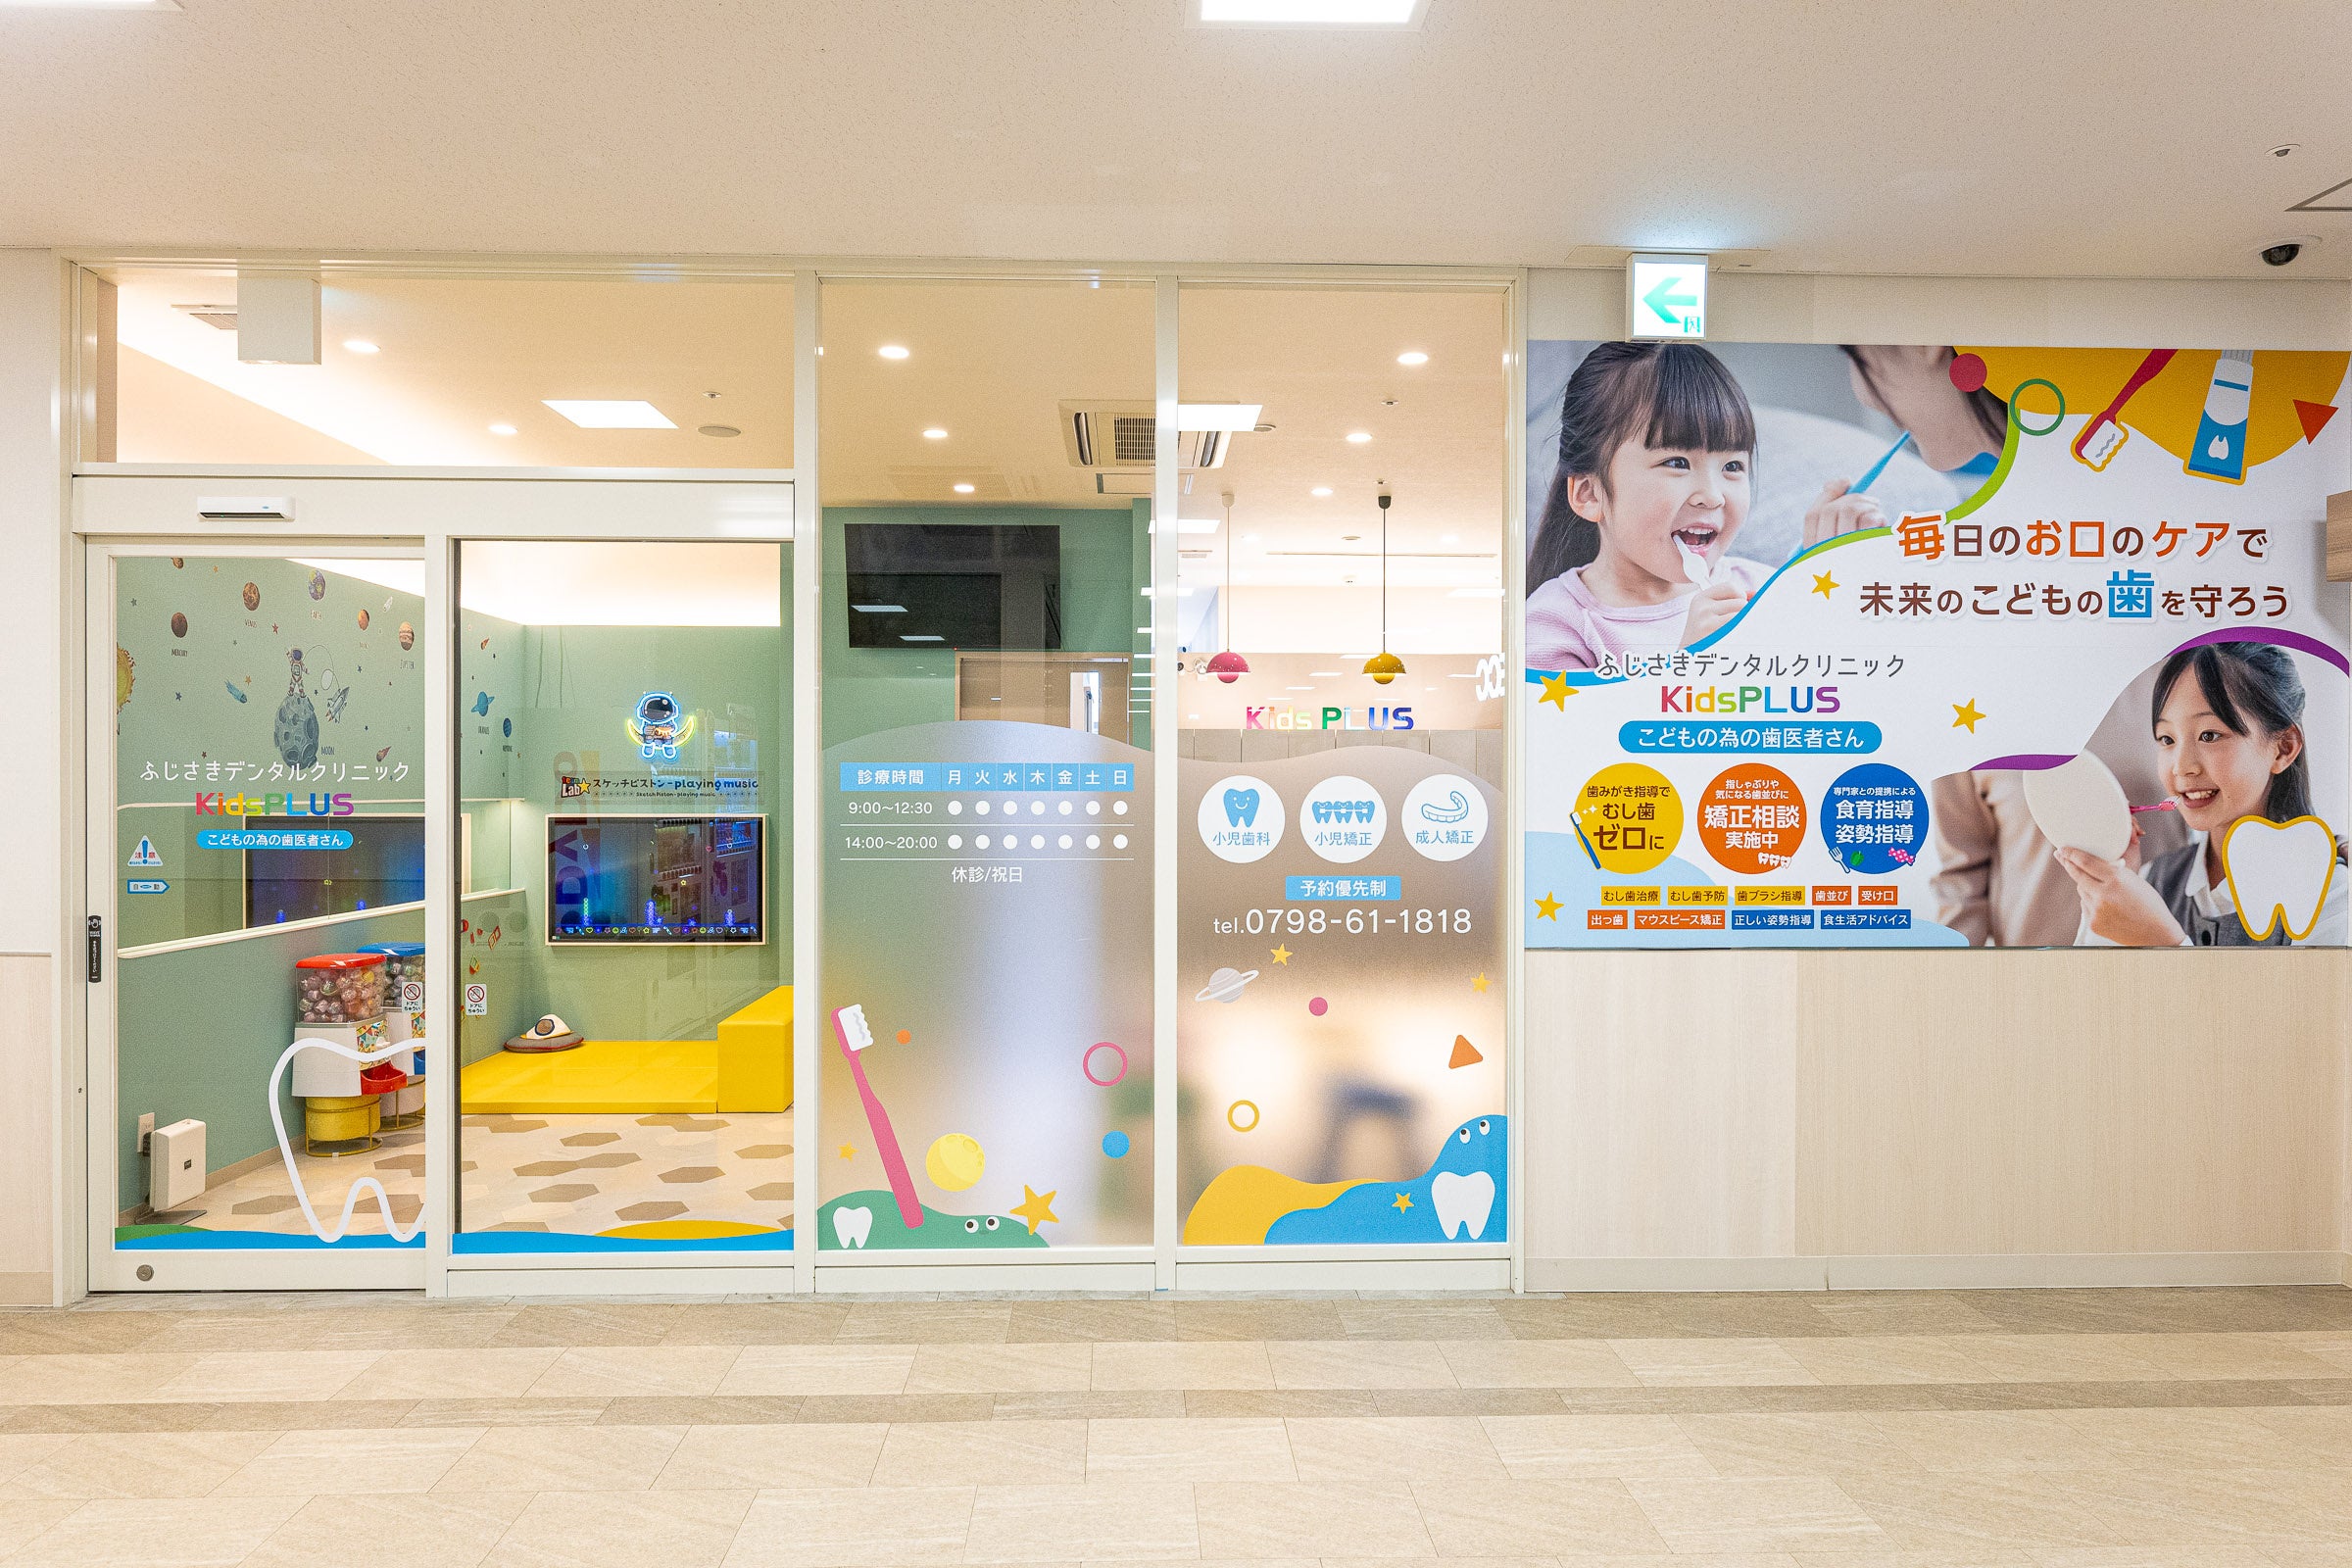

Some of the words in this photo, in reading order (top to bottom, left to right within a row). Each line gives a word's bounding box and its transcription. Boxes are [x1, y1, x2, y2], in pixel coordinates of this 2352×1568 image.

[1896, 514, 2268, 561] 毎日のお口のケアで
[1861, 569, 2287, 618] 未来のこどもの歯を守ろう
[1597, 653, 1905, 677] ふじさきデンタルクリニック
[1661, 686, 1840, 713] KidsPLUS
[1246, 707, 1313, 730] Kids
[1322, 707, 1414, 730] PLUS
[1638, 727, 1864, 748] こどもの為の歯医者さん
[139, 761, 410, 783] ふじさきデンタルクリニック
[858, 769, 924, 785] 診療時間
[948, 770, 961, 785] 月
[975, 769, 990, 785] 火
[1003, 769, 1018, 785] 水
[1030, 769, 1046, 785] 木
[1057, 769, 1073, 785] 金
[1085, 769, 1101, 785] 土
[1113, 769, 1127, 785] 日
[562, 784, 580, 798] Lab
[723, 779, 759, 788] music
[1725, 779, 1780, 790] 指しゃぶりや
[1587, 785, 1671, 799] 歯みがき指導で
[1715, 790, 1788, 800] 気になる歯並びに
[1833, 787, 1916, 797] 専門家との提携による
[195, 792, 355, 816] KidsPLUS
[1602, 803, 1655, 820] むし歯
[1836, 800, 1914, 820] 食育指導
[1704, 805, 1800, 829] 矯正相談
[207, 833, 344, 847] こどもの為の歯医者さん
[1212, 831, 1271, 847] 小児歯科
[1314, 831, 1373, 847] 小児矯正
[1415, 830, 1474, 845] 成人矯正
[1593, 823, 1665, 851] ゼロに
[1725, 831, 1779, 849] 実施中
[1835, 824, 1914, 844] 姿勢指導
[951, 867, 1023, 883] 休診/祝日
[1300, 880, 1387, 898] 予約優先制
[1603, 890, 1658, 902] むし歯治療
[1670, 890, 1725, 902] むし歯予防
[1737, 890, 1802, 902] 歯ブラシ指導
[1815, 890, 1848, 902] 歯並び
[1861, 890, 1894, 902] 受け口
[1591, 914, 1624, 926] 出っ歯
[1637, 914, 1722, 926] マウスピース矯正
[1734, 914, 1812, 926] 正しい姿勢指導
[1823, 914, 1908, 925] 食生活アドバイス
